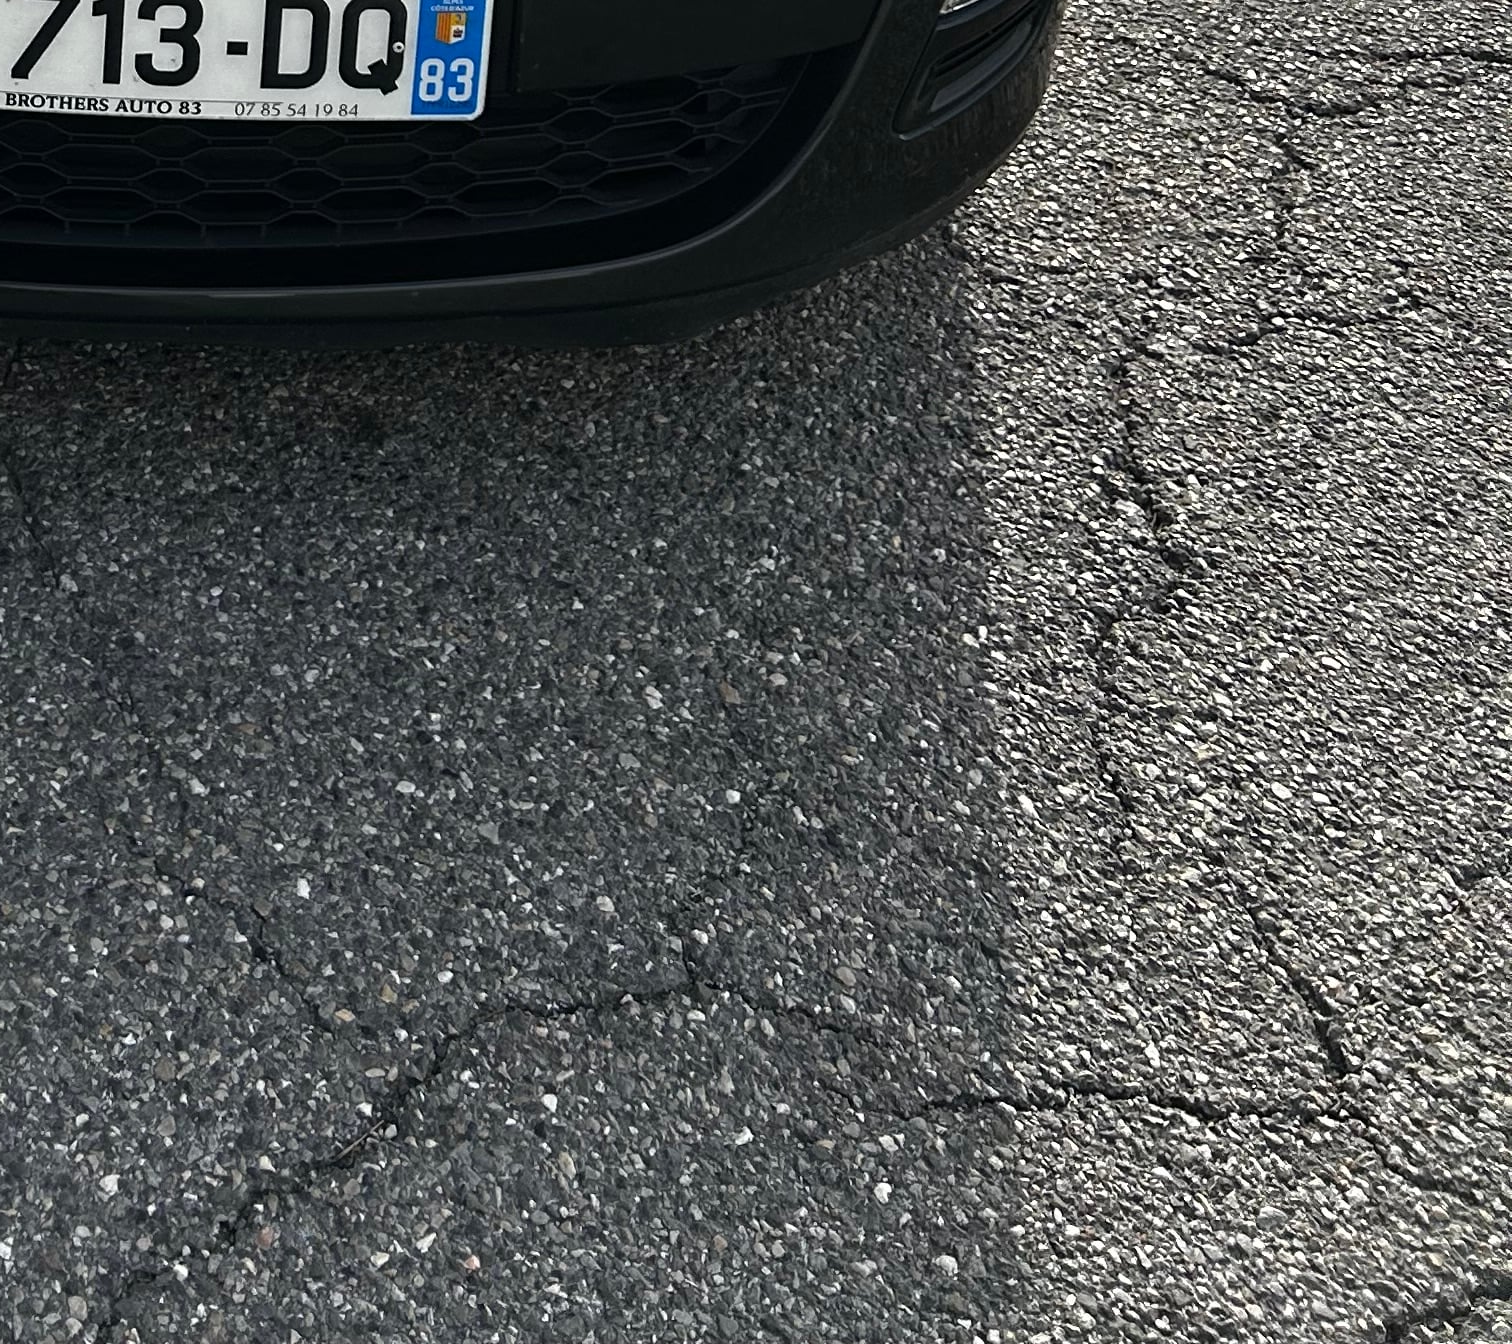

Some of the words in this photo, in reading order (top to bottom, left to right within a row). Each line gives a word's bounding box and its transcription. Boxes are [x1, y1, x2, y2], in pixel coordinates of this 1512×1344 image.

[418, 57, 475, 102] 83
[5, 92, 109, 112] BROTHERS
[115, 99, 173, 114] AUTO
[178, 101, 202, 115] 83
[234, 102, 256, 116] 07
[260, 102, 281, 116] 85
[286, 103, 306, 117] 54
[315, 103, 333, 117] 19
[338, 103, 358, 117] 84
